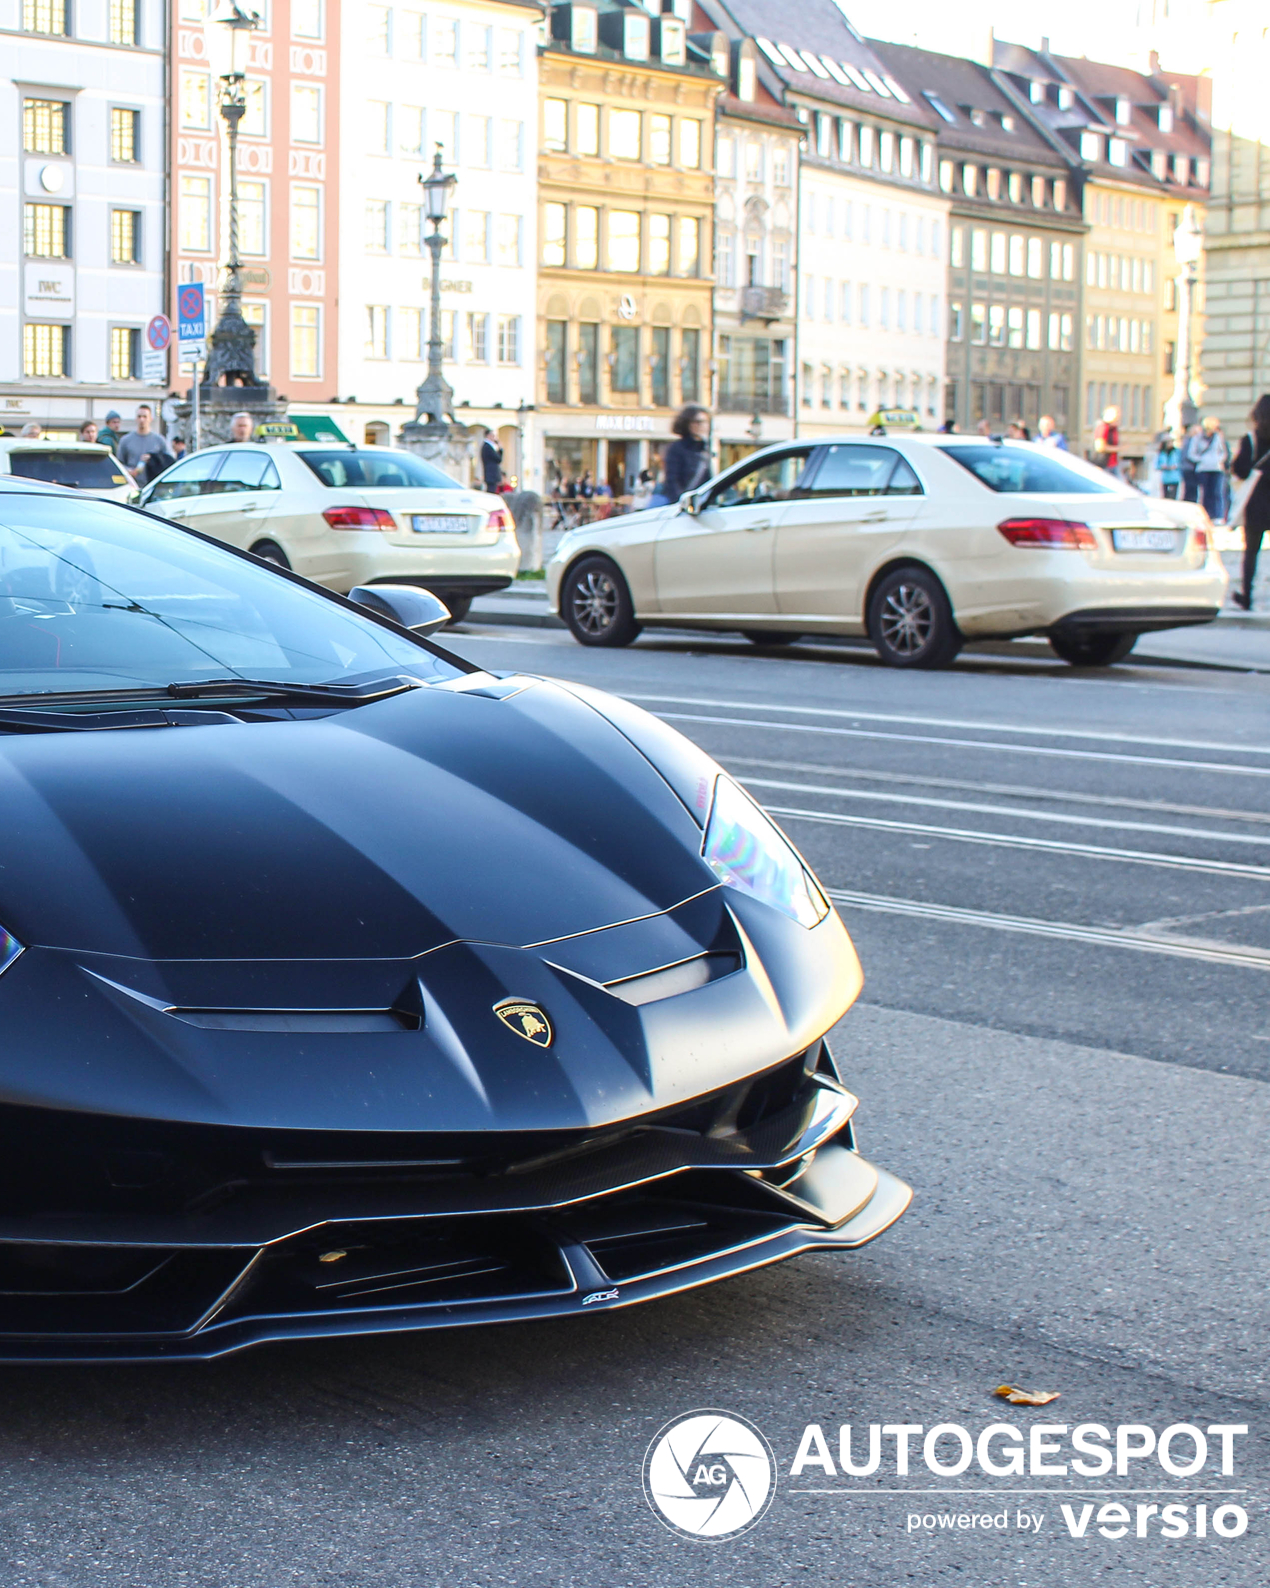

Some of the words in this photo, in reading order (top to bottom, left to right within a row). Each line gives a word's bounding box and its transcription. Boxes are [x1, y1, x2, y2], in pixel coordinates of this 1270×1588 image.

[38, 280, 62, 294] IWC
[422, 277, 473, 293] BGNER
[179, 323, 203, 337] TAXI
